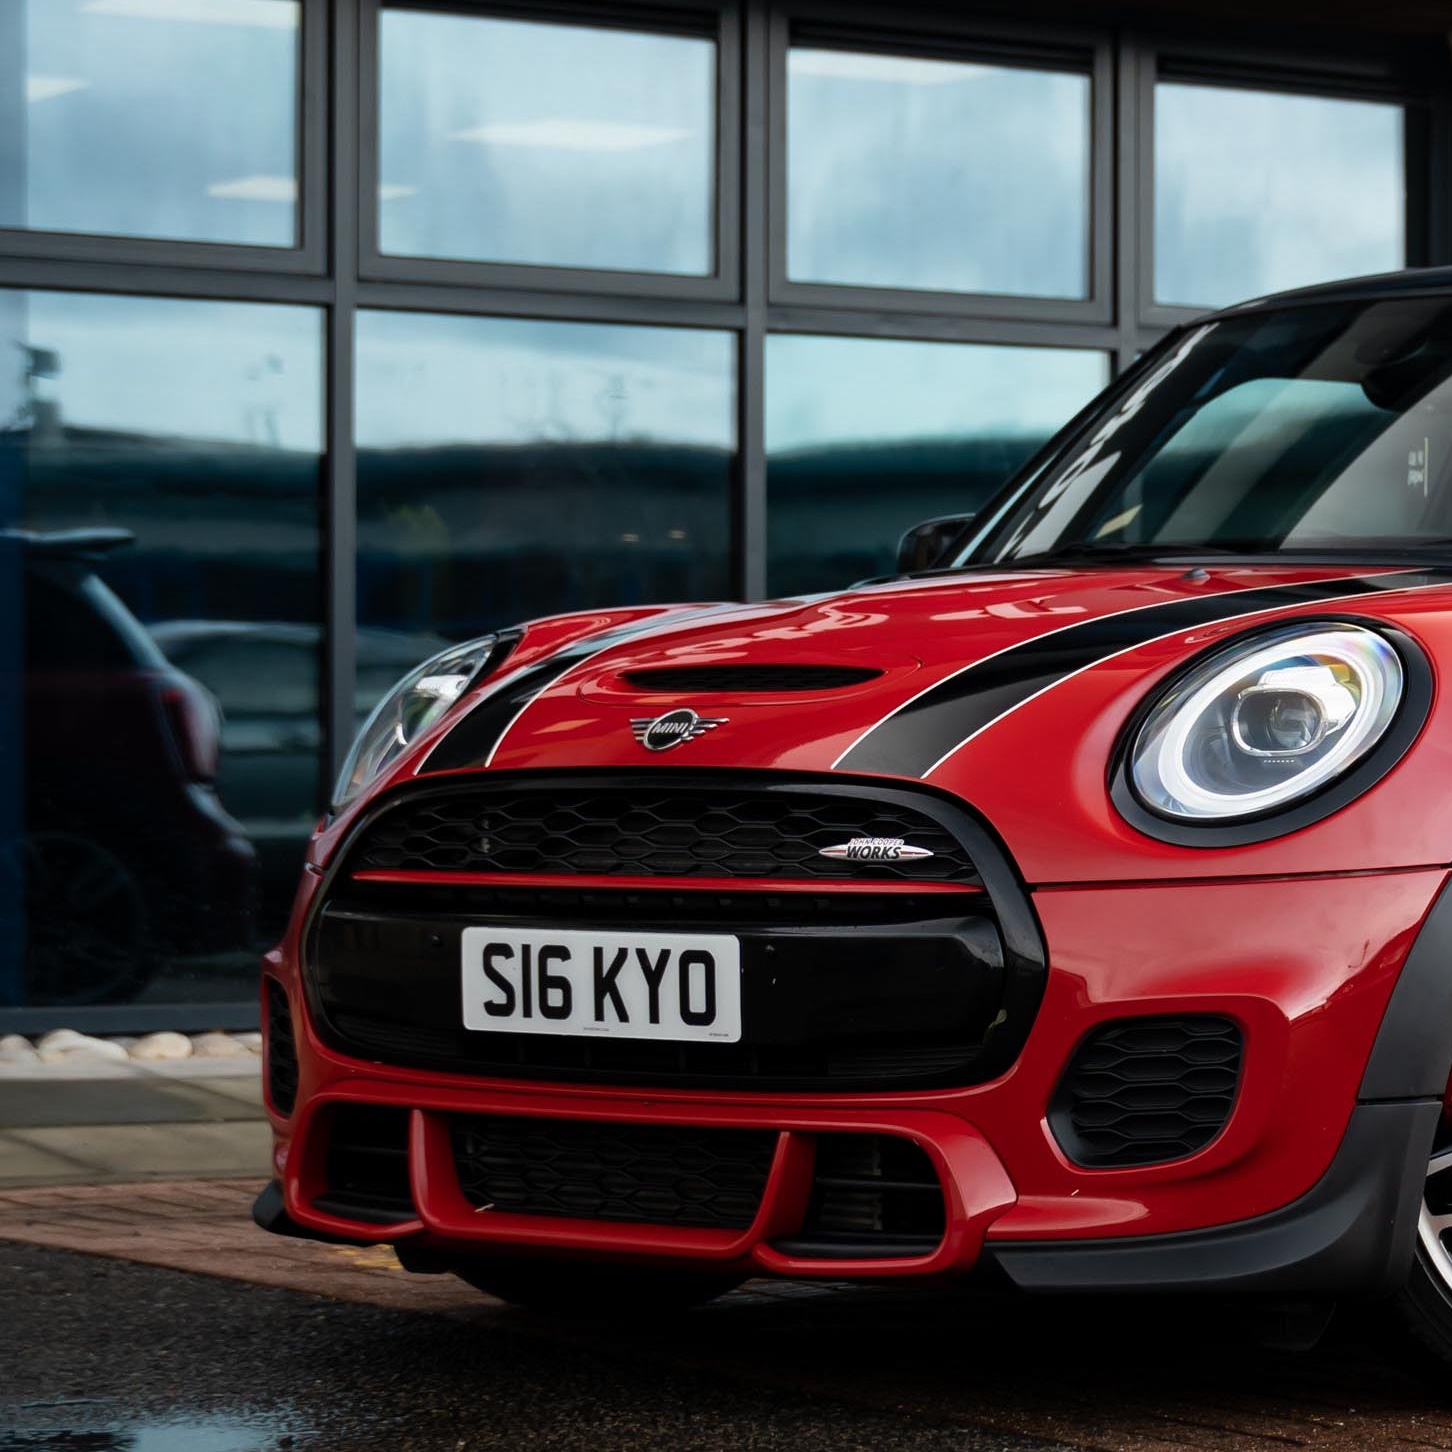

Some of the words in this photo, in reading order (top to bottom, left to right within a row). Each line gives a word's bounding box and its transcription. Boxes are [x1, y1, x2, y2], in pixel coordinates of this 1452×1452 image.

[651, 722, 689, 734] MINI
[846, 845, 902, 860] WORKS
[482, 942, 573, 1021] S16
[592, 946, 717, 1027] KYO
